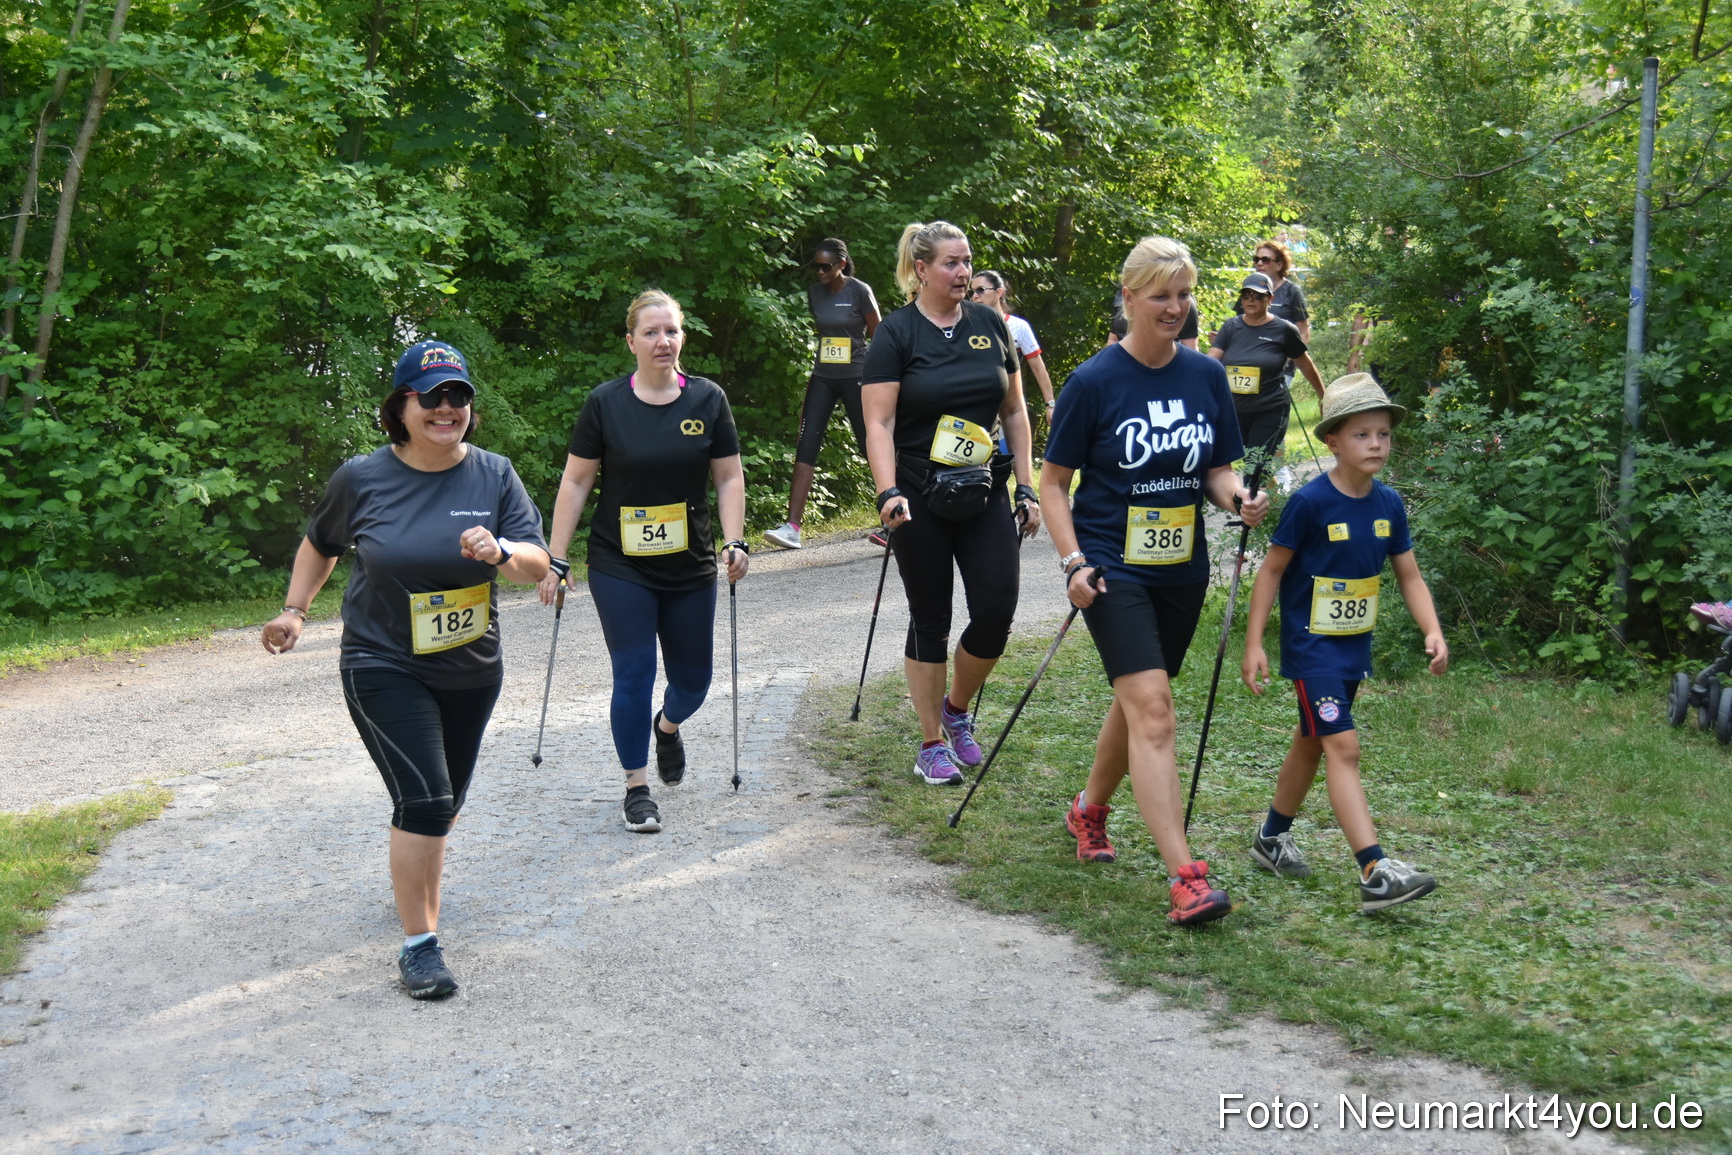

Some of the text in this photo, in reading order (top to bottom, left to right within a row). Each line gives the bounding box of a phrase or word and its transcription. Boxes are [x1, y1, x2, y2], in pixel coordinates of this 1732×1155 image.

[826, 346, 842, 356] 161
[1233, 376, 1251, 387] 172
[954, 436, 974, 457] 78
[1115, 413, 1213, 474] Burgis
[1131, 476, 1201, 495] Knödellieb
[642, 523, 668, 542] 54
[1143, 528, 1183, 549] 386
[1329, 598, 1368, 619] 388
[432, 607, 474, 635] 182
[431, 627, 474, 642] Werner Carmen
